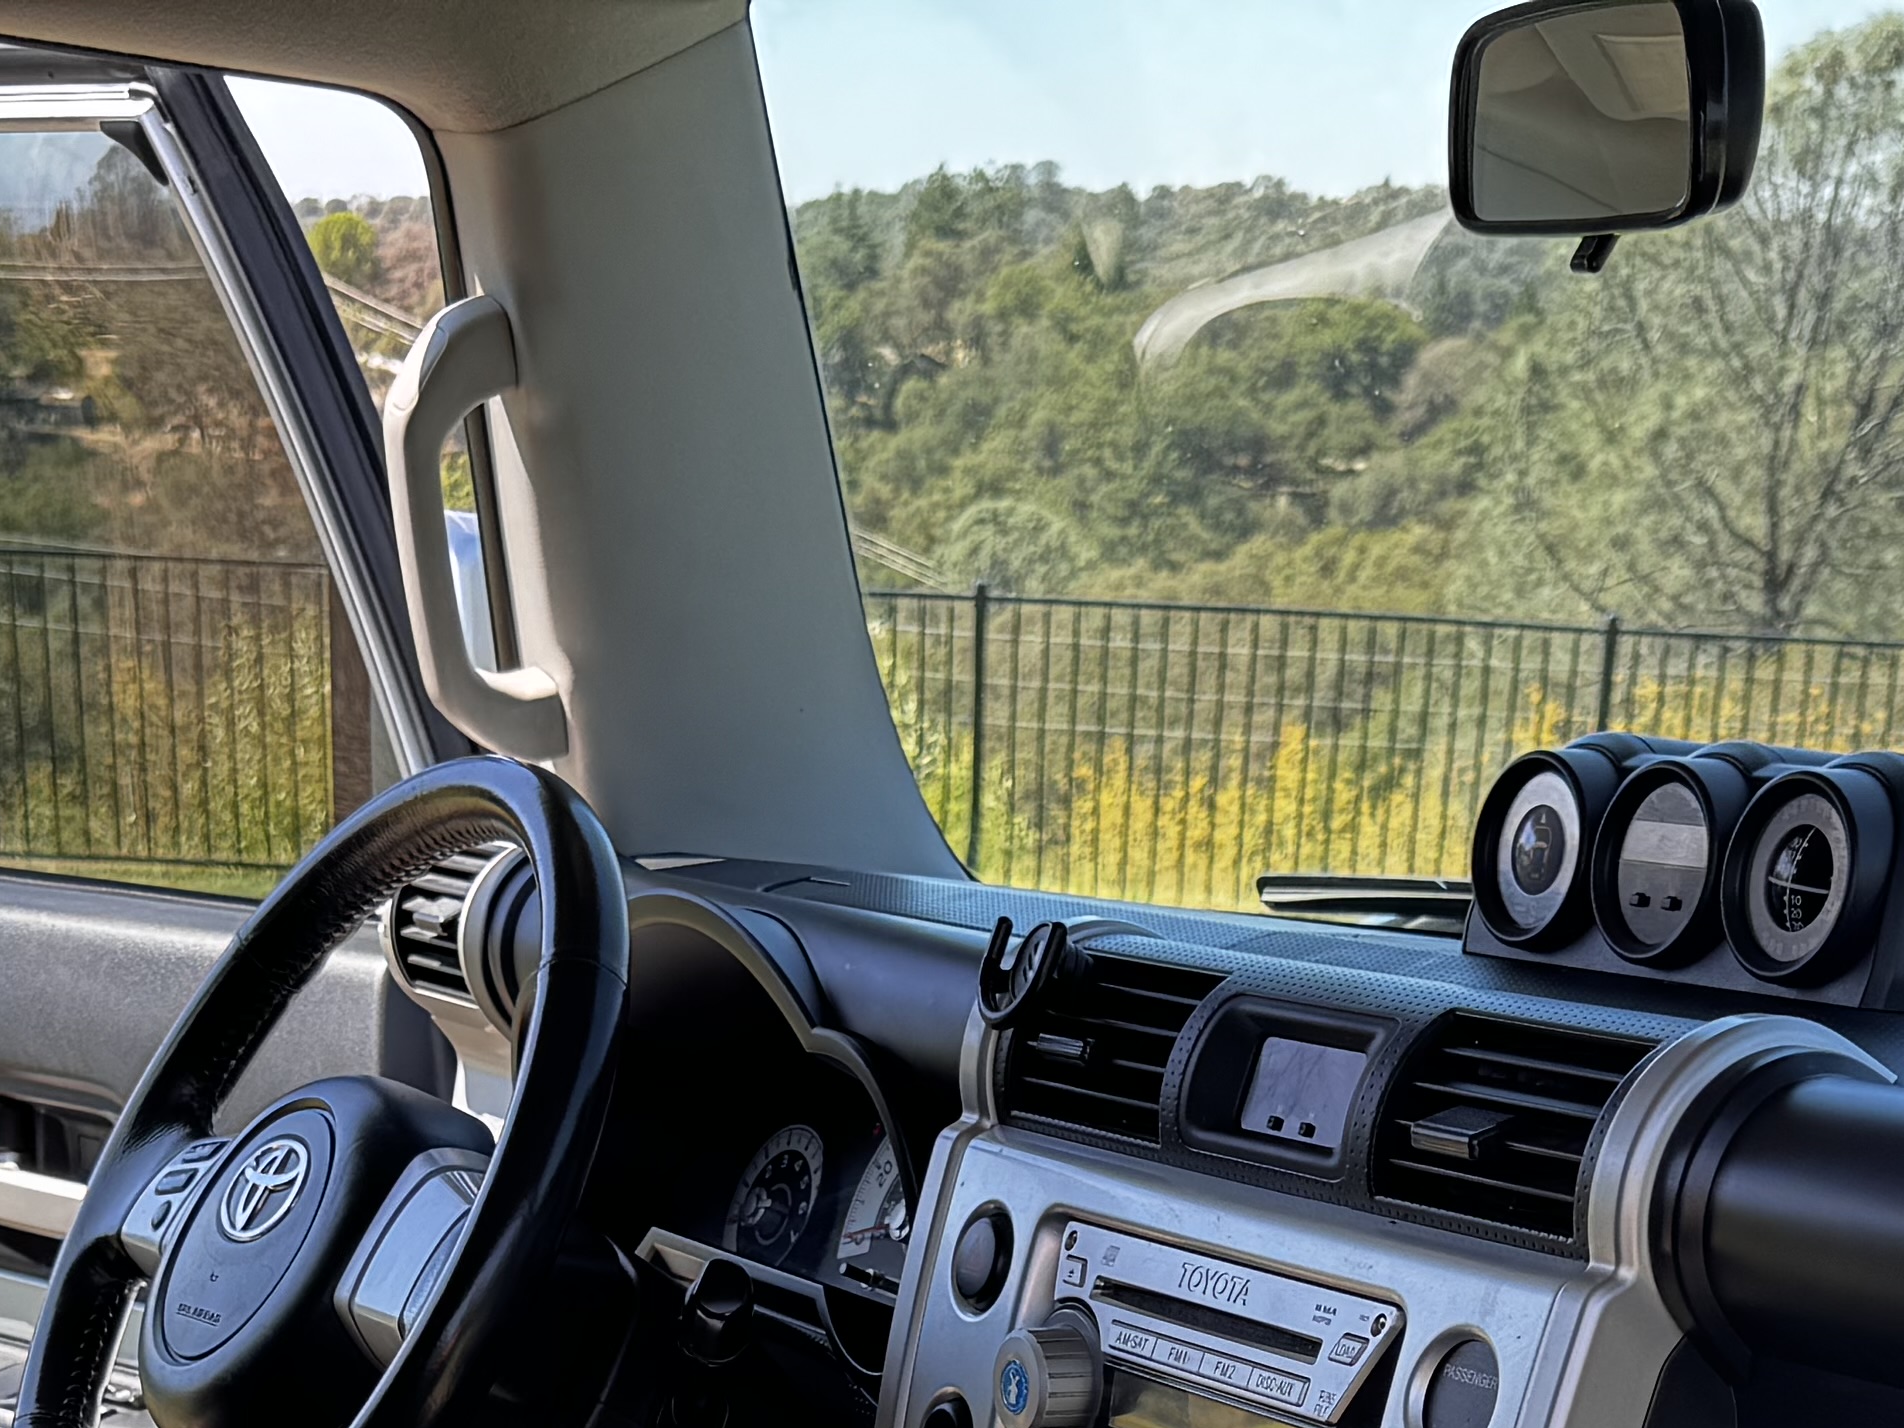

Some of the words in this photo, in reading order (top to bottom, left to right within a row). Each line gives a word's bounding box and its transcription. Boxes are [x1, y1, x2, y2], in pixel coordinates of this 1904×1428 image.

[1791, 895, 1802, 906] 10
[781, 1154, 789, 1168] 3
[877, 1160, 893, 1188] 20
[1178, 1262, 1251, 1306] TOYOTA
[1167, 1347, 1189, 1365] FM1
[1214, 1361, 1236, 1380] FM2
[1443, 1363, 1498, 1390] PASSENGER
